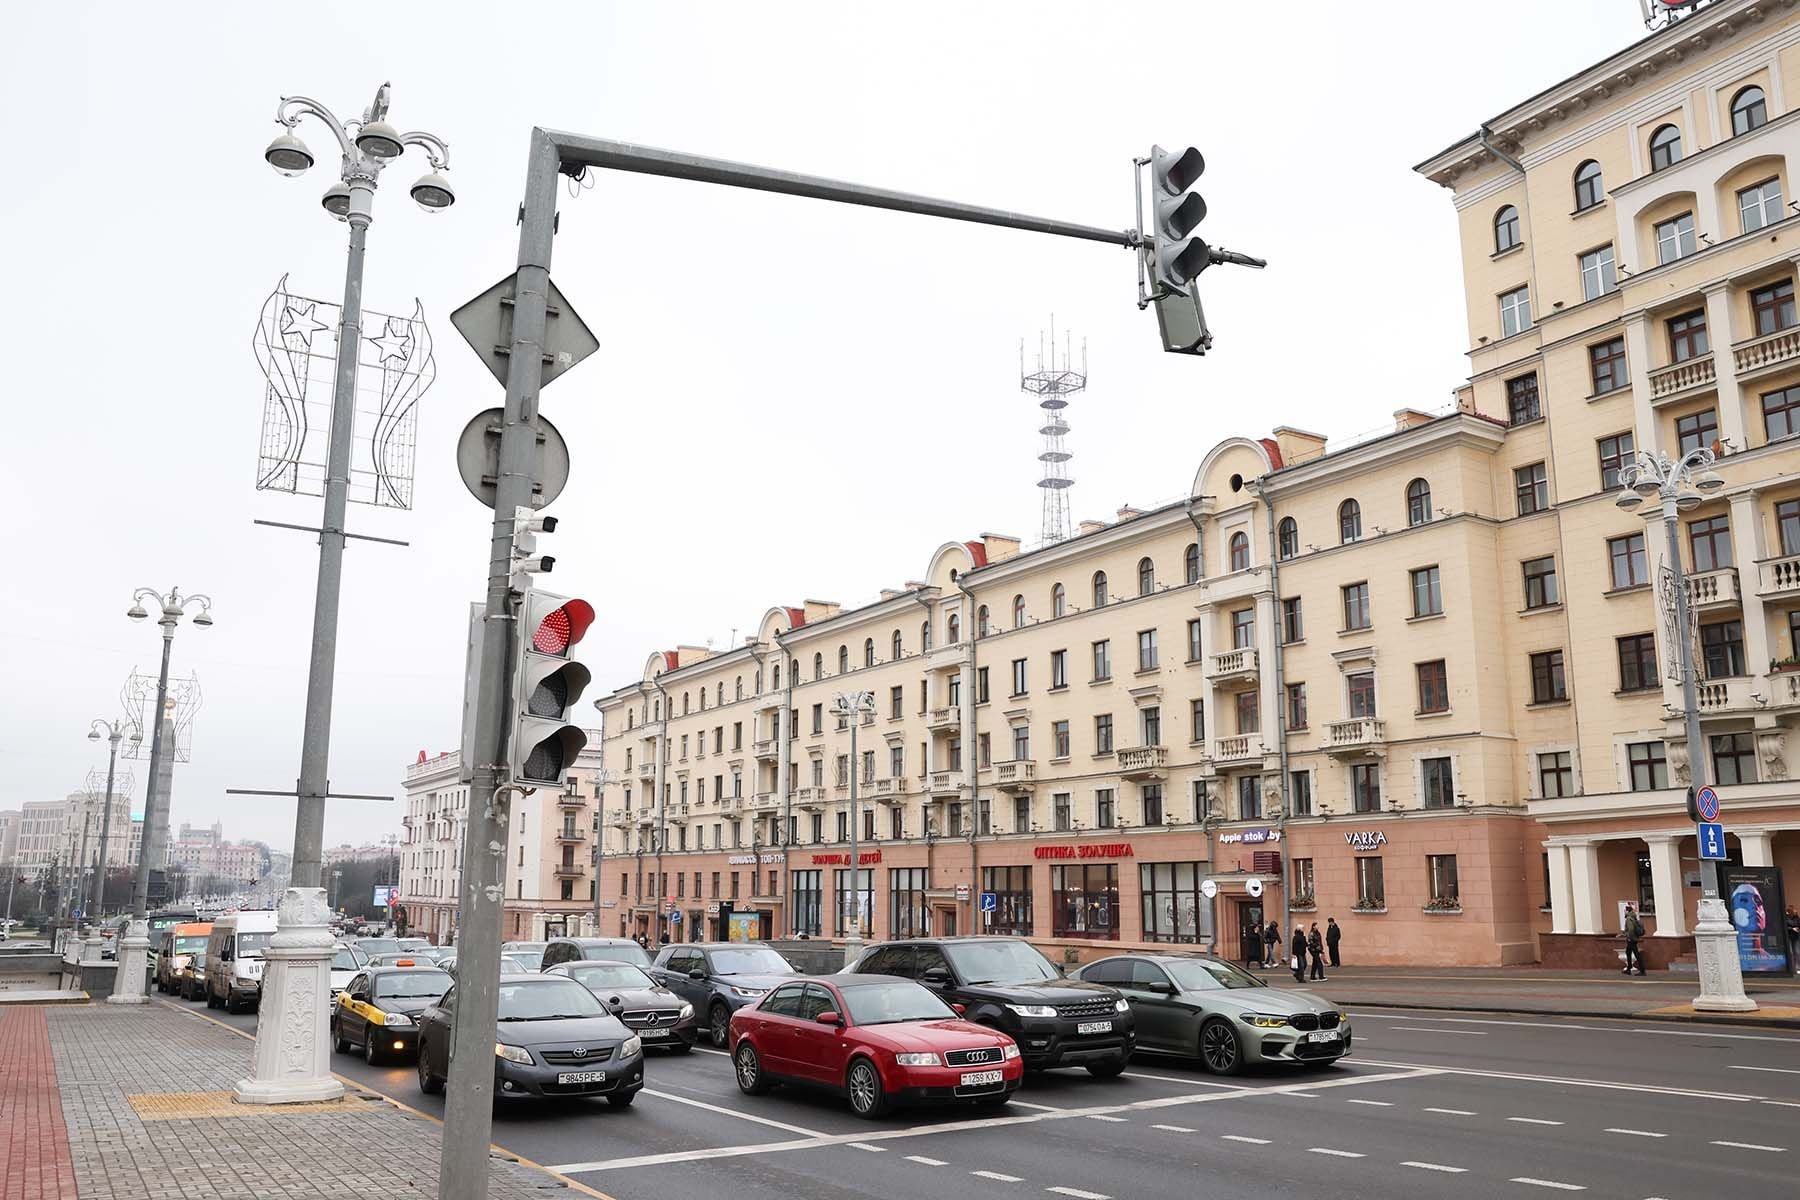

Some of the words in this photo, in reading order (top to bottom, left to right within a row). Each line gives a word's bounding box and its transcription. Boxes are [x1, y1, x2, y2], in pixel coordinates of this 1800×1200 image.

[1219, 833, 1241, 843] Apple
[1244, 831, 1264, 841] stok
[1344, 831, 1387, 845] VARKA
[1034, 846, 1076, 859] ОПТИКА
[1078, 843, 1134, 858] ЗОЛУШКА
